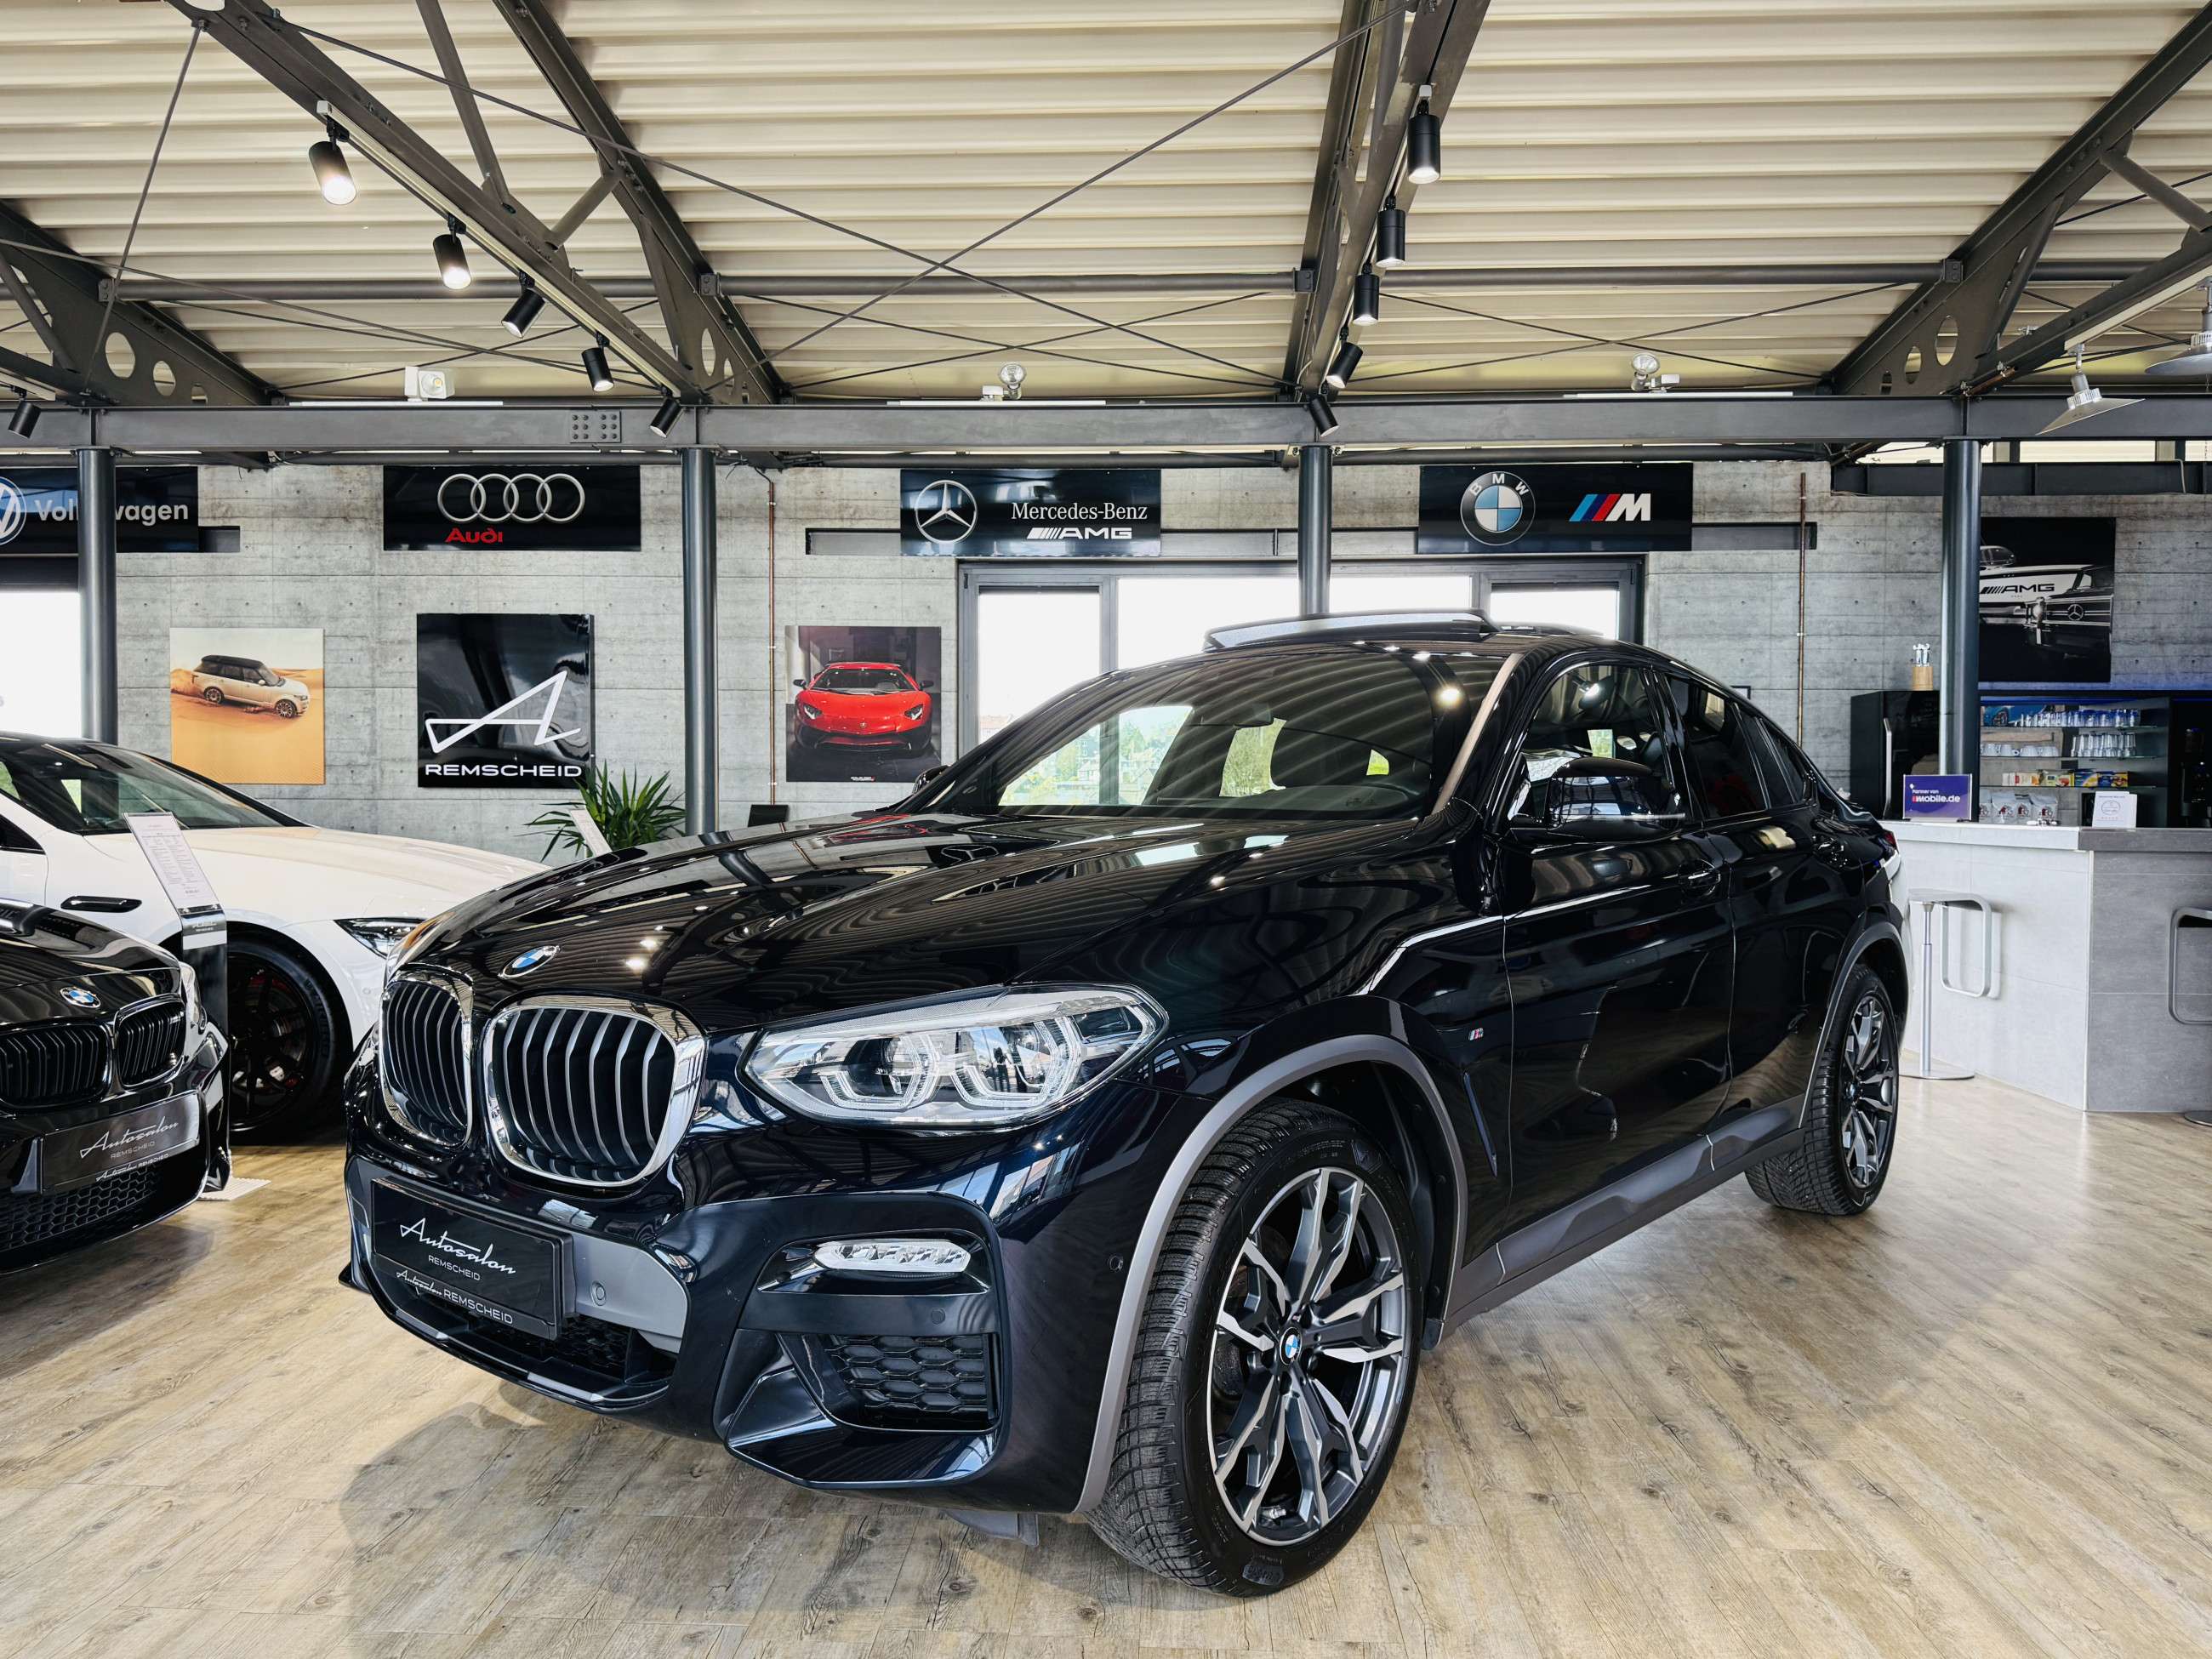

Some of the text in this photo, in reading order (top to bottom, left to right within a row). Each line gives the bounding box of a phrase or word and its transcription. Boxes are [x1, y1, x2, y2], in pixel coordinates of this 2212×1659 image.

[1469, 473, 1530, 496] BMW
[34, 498, 189, 527] Volagen
[1011, 503, 1148, 520] Mercedes-Benz
[444, 527, 503, 544] Audi
[1059, 527, 1132, 539] AMG
[2001, 584, 2055, 593] AMG
[425, 764, 582, 778] REMSCHEID
[80, 1115, 179, 1159] Autosalon
[400, 1217, 516, 1274] Autosalon
[428, 1254, 481, 1281] REMSCHEID
[396, 1269, 513, 1325] Autosalon REMSCHEID
